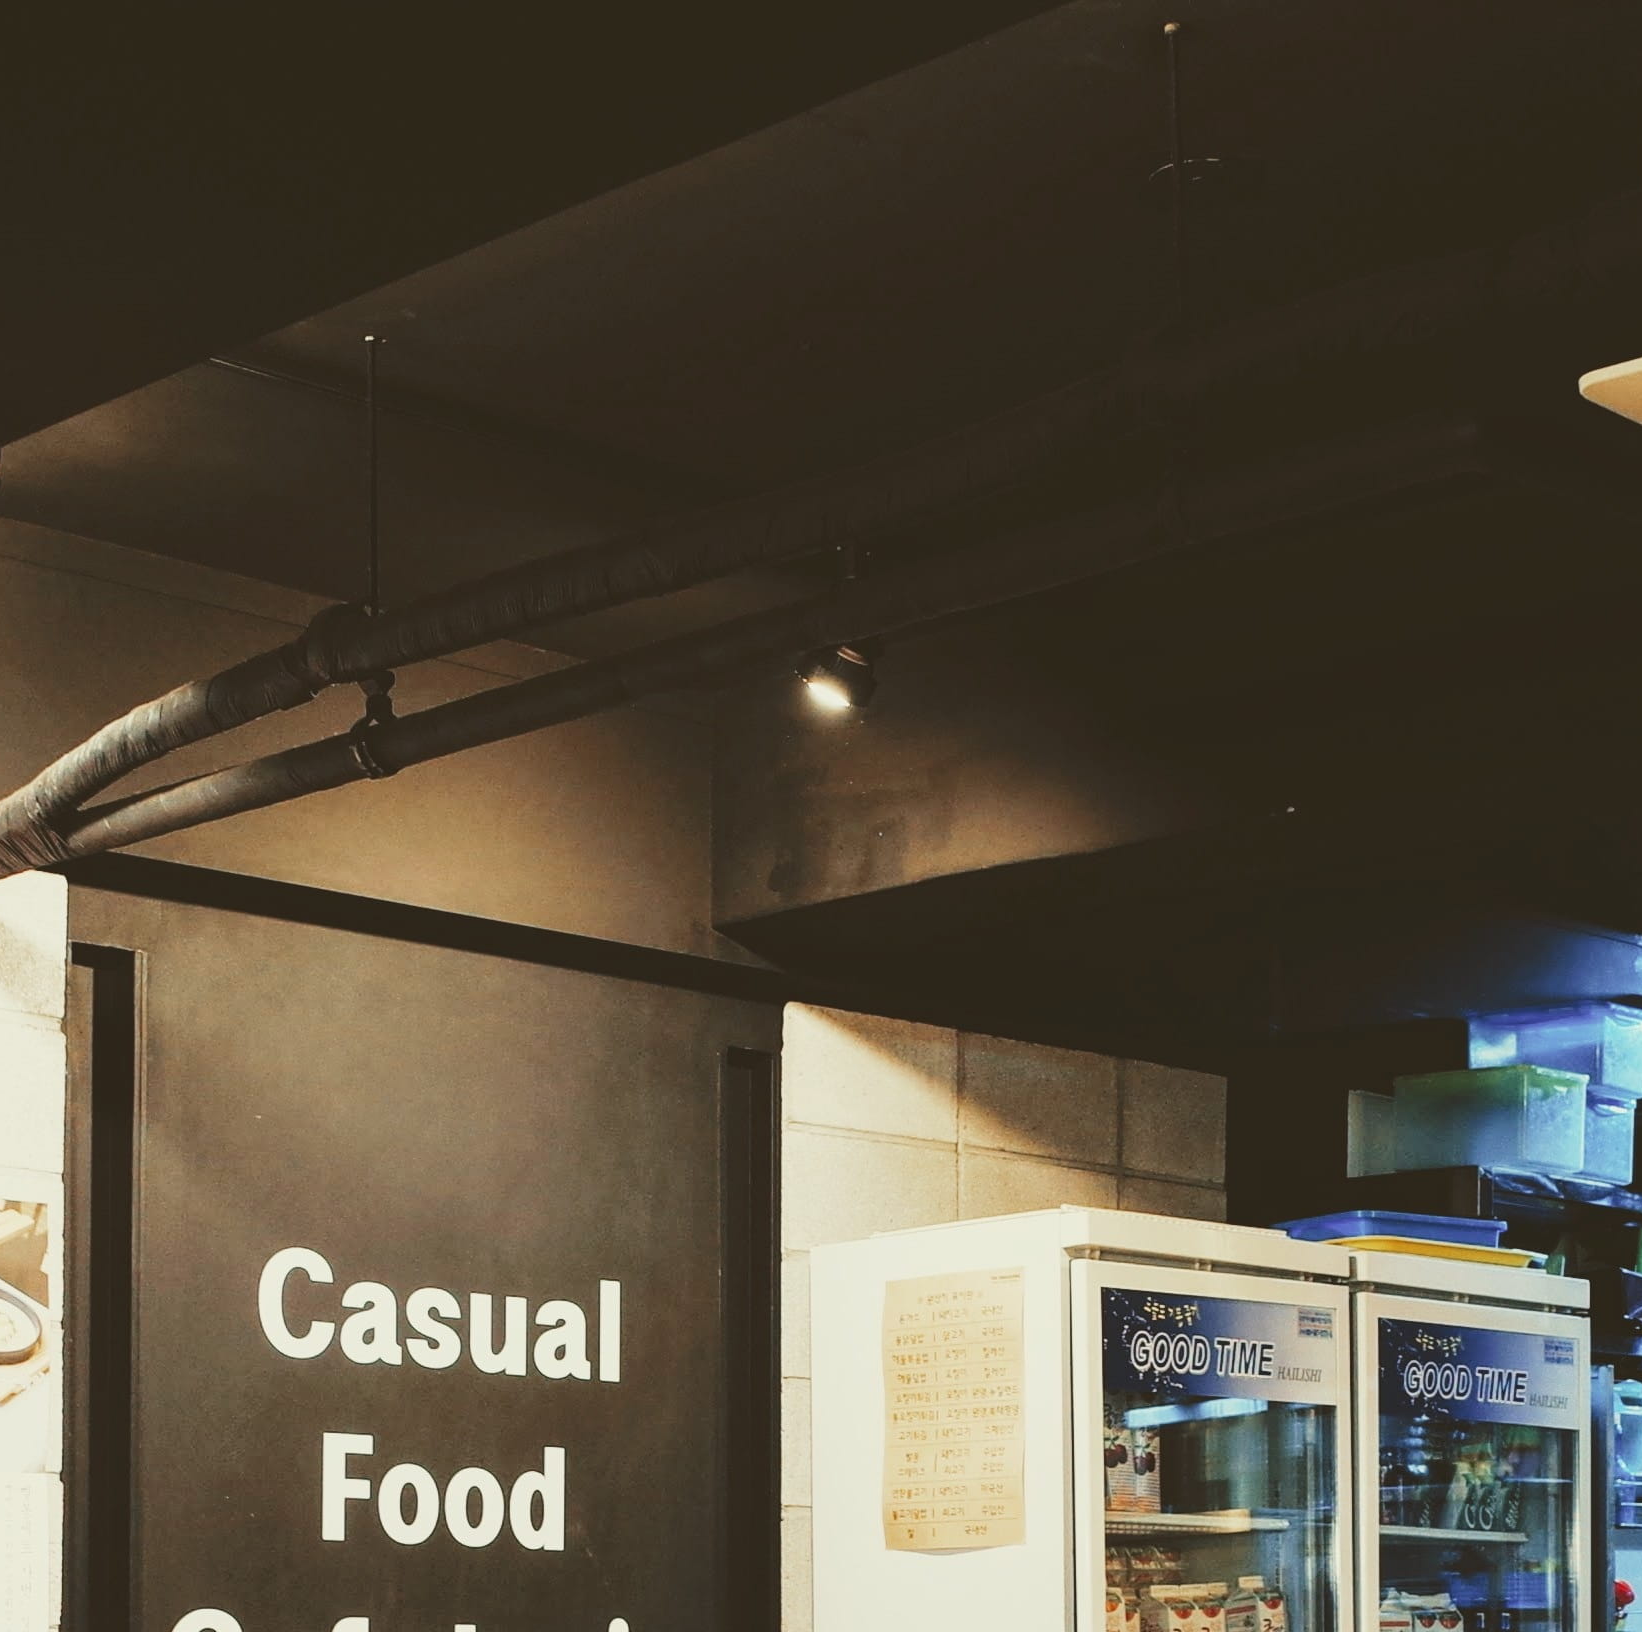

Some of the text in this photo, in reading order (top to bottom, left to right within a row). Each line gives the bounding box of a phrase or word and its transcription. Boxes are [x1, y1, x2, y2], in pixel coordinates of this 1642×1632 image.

[256, 1245, 622, 1384] Casual
[1131, 1331, 1211, 1375] GOOD
[1214, 1337, 1275, 1379] TIME
[1404, 1360, 1472, 1399] GOOD
[1476, 1367, 1528, 1405] TIME
[320, 1431, 566, 1552] Food
